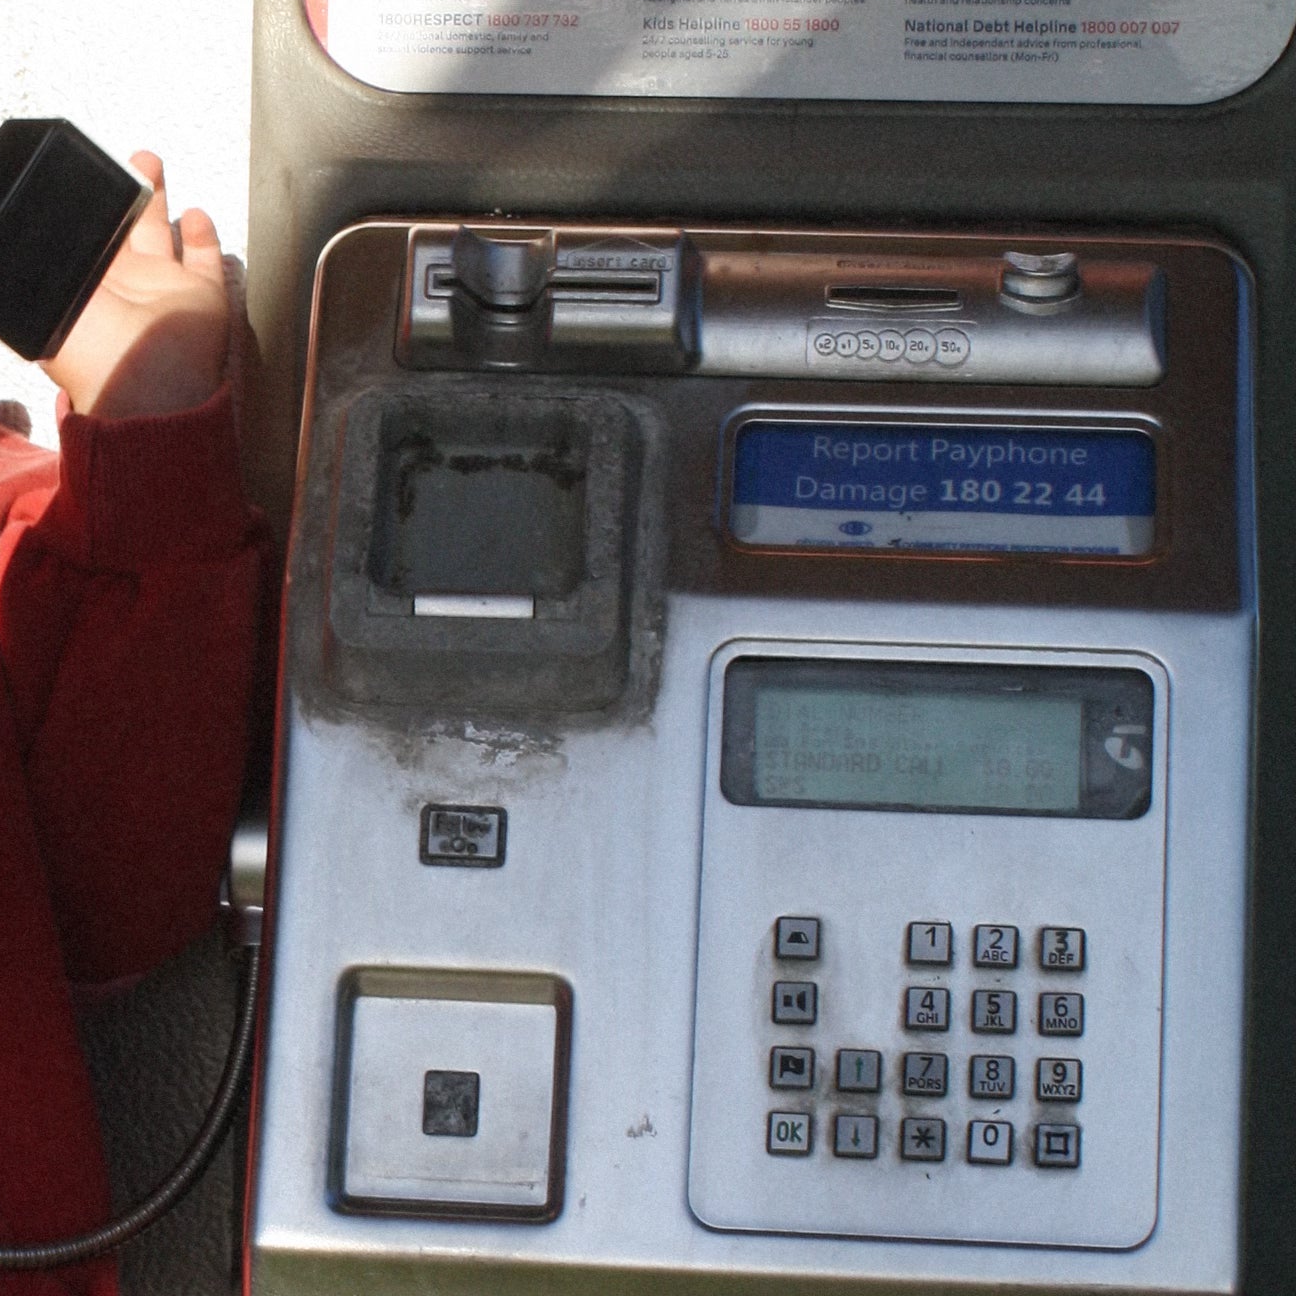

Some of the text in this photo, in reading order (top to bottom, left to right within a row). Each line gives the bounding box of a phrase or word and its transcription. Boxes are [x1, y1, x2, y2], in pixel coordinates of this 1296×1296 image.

[379, 13, 579, 27] 1800RESPECT 1800 737 732
[642, 17, 840, 33] Kids Helpline 1800 55 1800
[905, 20, 1180, 35] National Debt Helpline 1800 007 007
[497, 32, 528, 43] family
[530, 33, 549, 42] and
[642, 35, 814, 48] 24/7 counselling service for young
[905, 38, 926, 48] Free
[929, 38, 947, 48] and
[1016, 38, 1050, 48] advice
[1053, 39, 1076, 49] from
[1079, 39, 1142, 51] professional
[456, 46, 494, 56] support
[497, 46, 532, 55] service
[642, 49, 677, 60] people
[679, 49, 704, 60] aged
[904, 51, 947, 61] financial
[1010, 51, 1059, 63] (Mon-Fri)
[630, 255, 667, 269] card
[813, 436, 1088, 469] Report Payphone
[795, 476, 1104, 508] Damage 180 22 44
[924, 926, 937, 948] 1
[989, 928, 1004, 950] 2
[1054, 931, 1069, 953] 3
[982, 950, 1009, 962] ABC
[1048, 953, 1074, 965] DEF
[920, 990, 935, 1012] 4
[987, 994, 1001, 1014] 5
[1054, 997, 1068, 1017] 6
[916, 1012, 939, 1024] GHI
[983, 1016, 1004, 1027] JKL
[1045, 1018, 1078, 1029] MNO
[919, 1057, 934, 1078] 7
[985, 1060, 1000, 1081] 8
[1053, 1063, 1067, 1084] 9
[908, 1078, 942, 1090] PQRS
[979, 1081, 1005, 1093] TUV
[1042, 1084, 1076, 1097] WXYZ
[775, 1120, 803, 1144] OK
